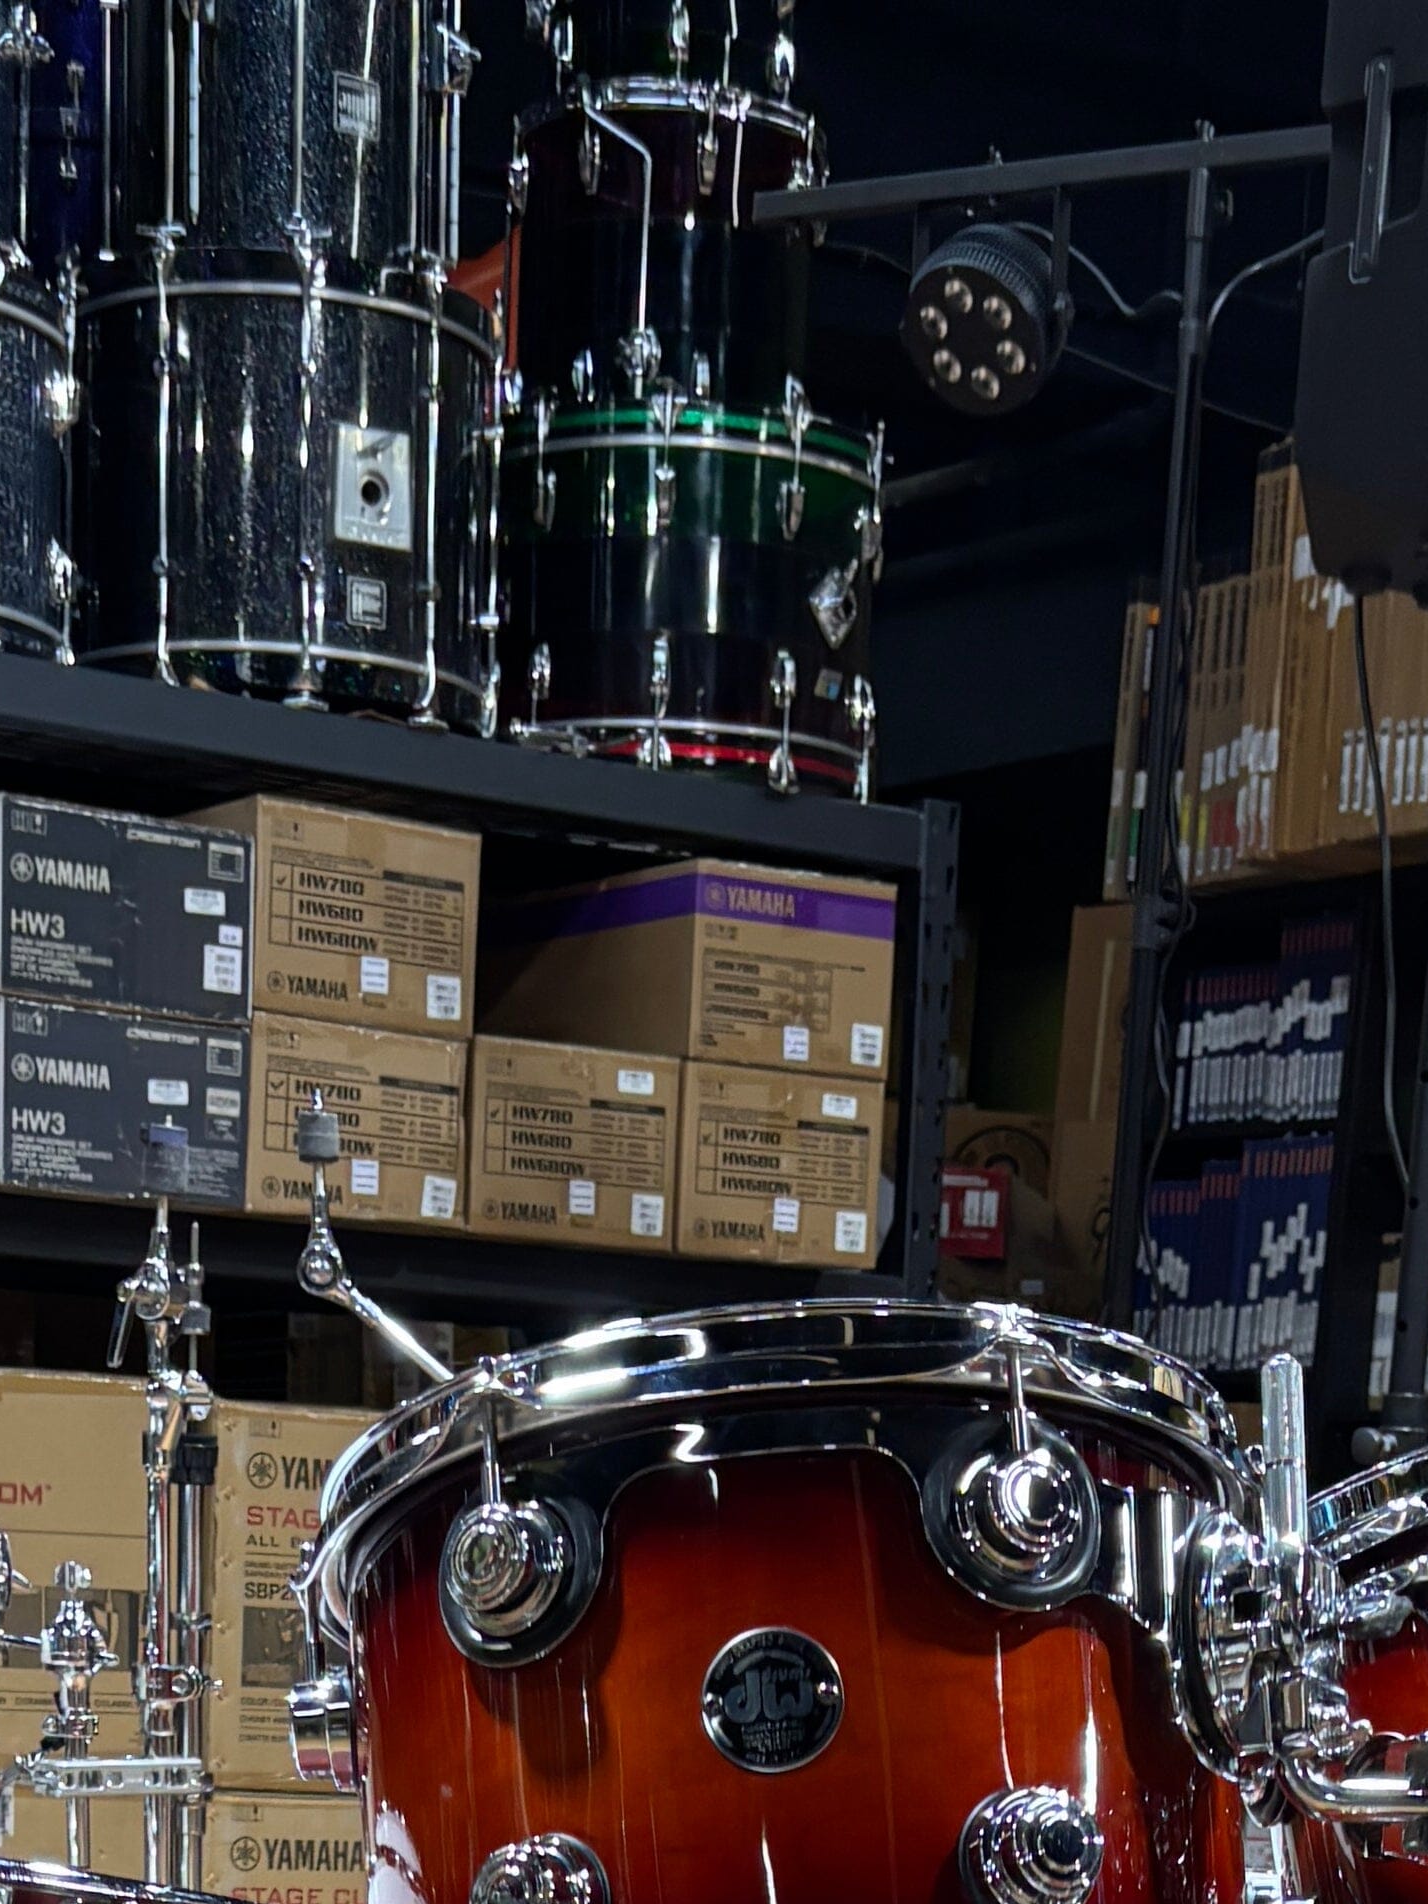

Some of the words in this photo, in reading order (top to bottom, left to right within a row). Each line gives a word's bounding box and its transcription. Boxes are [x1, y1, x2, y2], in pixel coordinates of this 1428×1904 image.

[34, 856, 111, 895] YAMAHA
[726, 886, 796, 918] YAMAHA
[10, 907, 66, 939] HW3
[287, 974, 349, 1001] YAMAHA
[35, 1056, 111, 1092] YAMAHA
[11, 1106, 66, 1136] HW3
[501, 1201, 558, 1226] YAMAHA
[711, 1219, 766, 1243] YAMAHA
[245, 1534, 281, 1548] ALL
[724, 1669, 814, 1724] dw
[263, 1838, 365, 1873] YAMAHA
